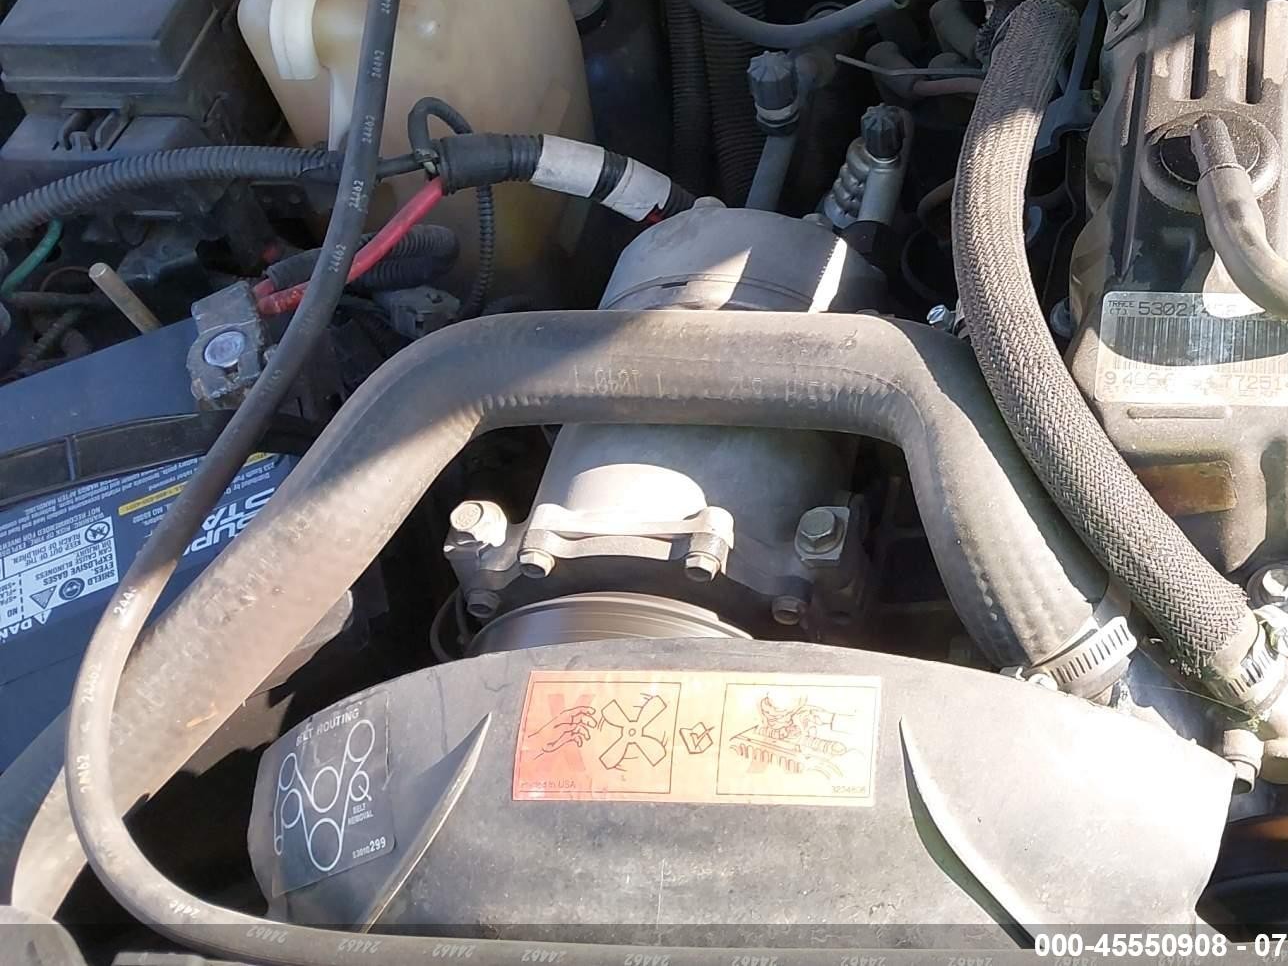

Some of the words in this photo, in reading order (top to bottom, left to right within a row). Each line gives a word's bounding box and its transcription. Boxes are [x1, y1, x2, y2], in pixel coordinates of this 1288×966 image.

[70, 553, 113, 576] EXPLOSIVE
[75, 552, 97, 565] CAUSE
[36, 561, 73, 580] BLINDNESS
[42, 572, 68, 586] GASES
[87, 569, 115, 586] SHIELD
[7, 607, 18, 618] NO
[316, 708, 360, 735] ROUTING
[338, 937, 383, 955] 24462
